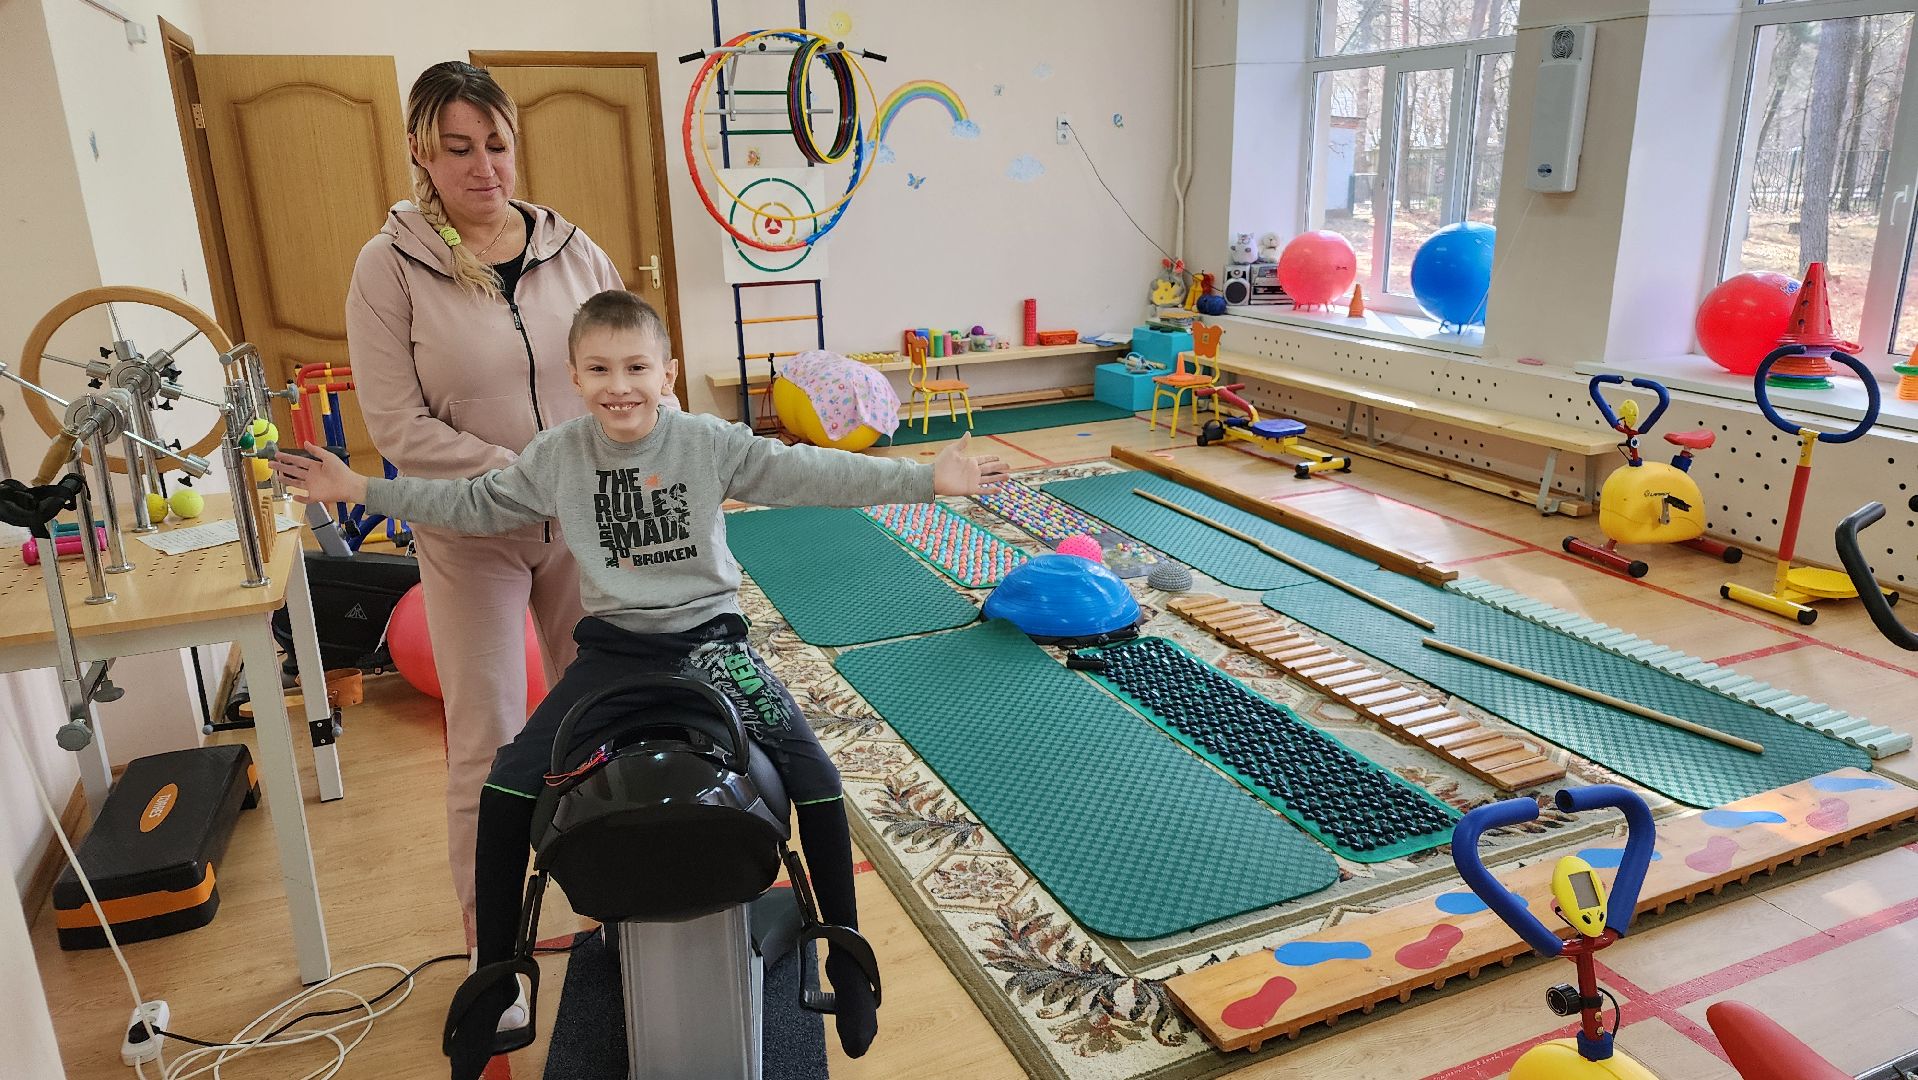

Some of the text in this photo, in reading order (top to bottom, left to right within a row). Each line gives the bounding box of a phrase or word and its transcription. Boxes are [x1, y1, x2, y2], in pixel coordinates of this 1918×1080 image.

[595, 467, 642, 493] THE
[593, 483, 691, 523] RULES
[598, 522, 613, 548] ARE
[611, 511, 691, 549] MADE
[632, 544, 698, 567] BROKEN
